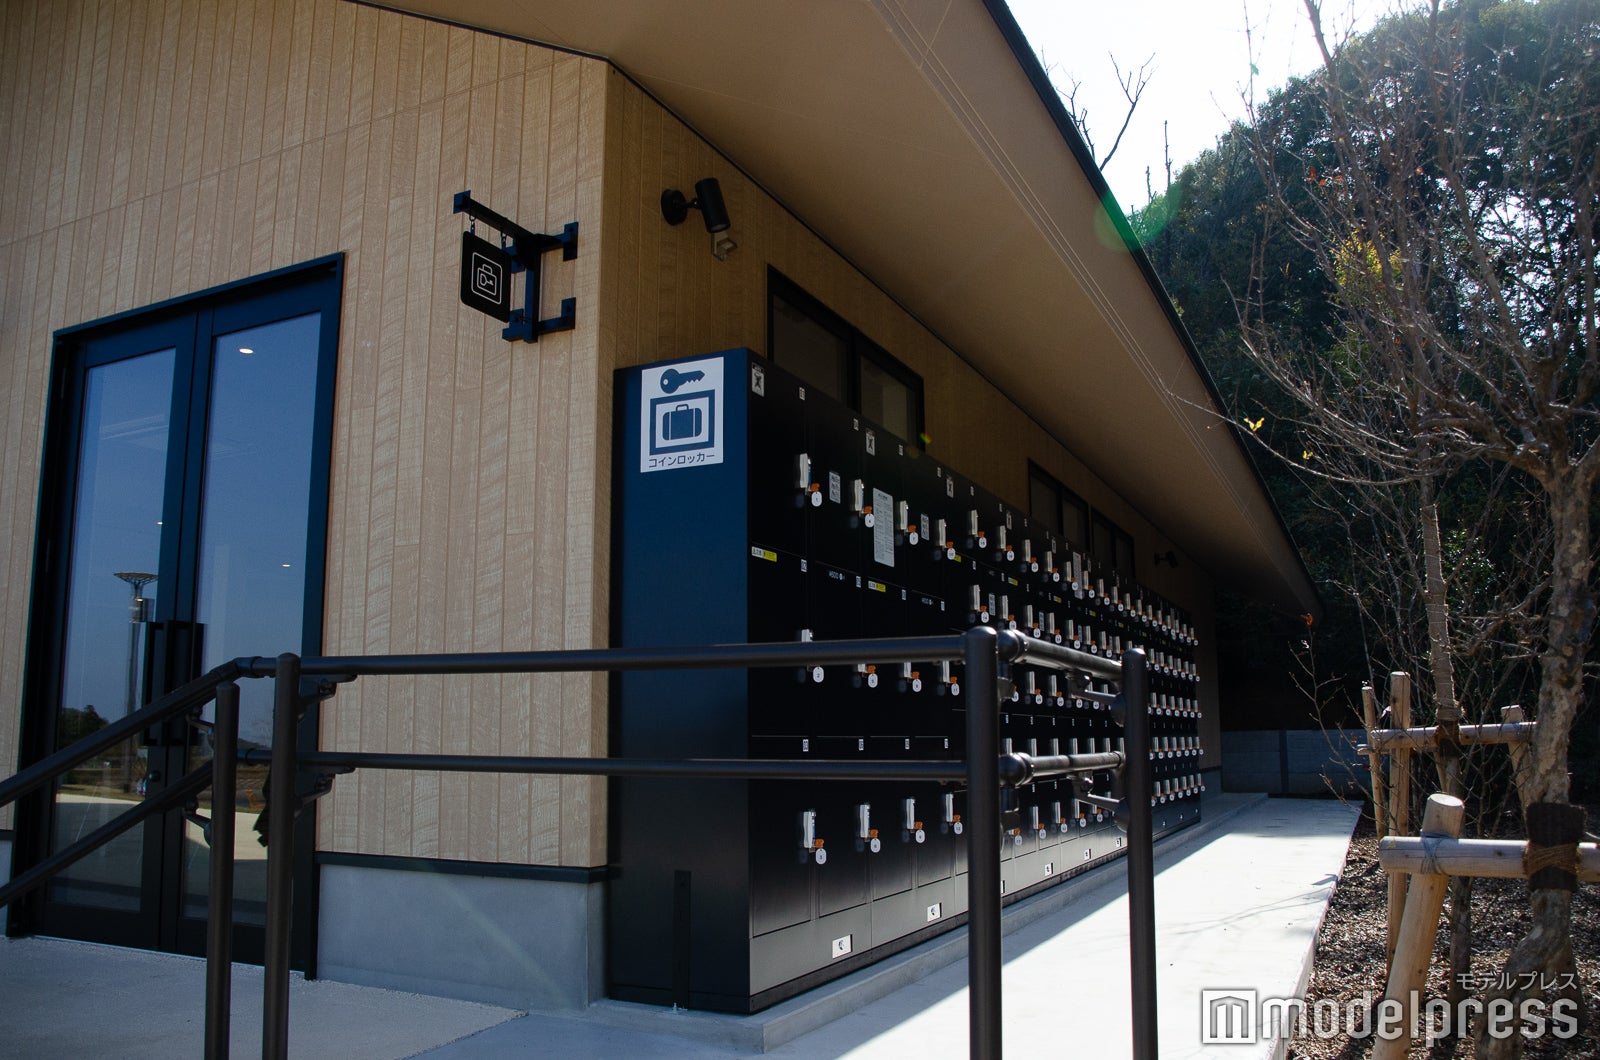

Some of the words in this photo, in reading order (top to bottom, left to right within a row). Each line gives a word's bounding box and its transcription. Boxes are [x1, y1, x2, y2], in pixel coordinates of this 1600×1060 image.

[648, 452, 715, 469] コインロッカー
